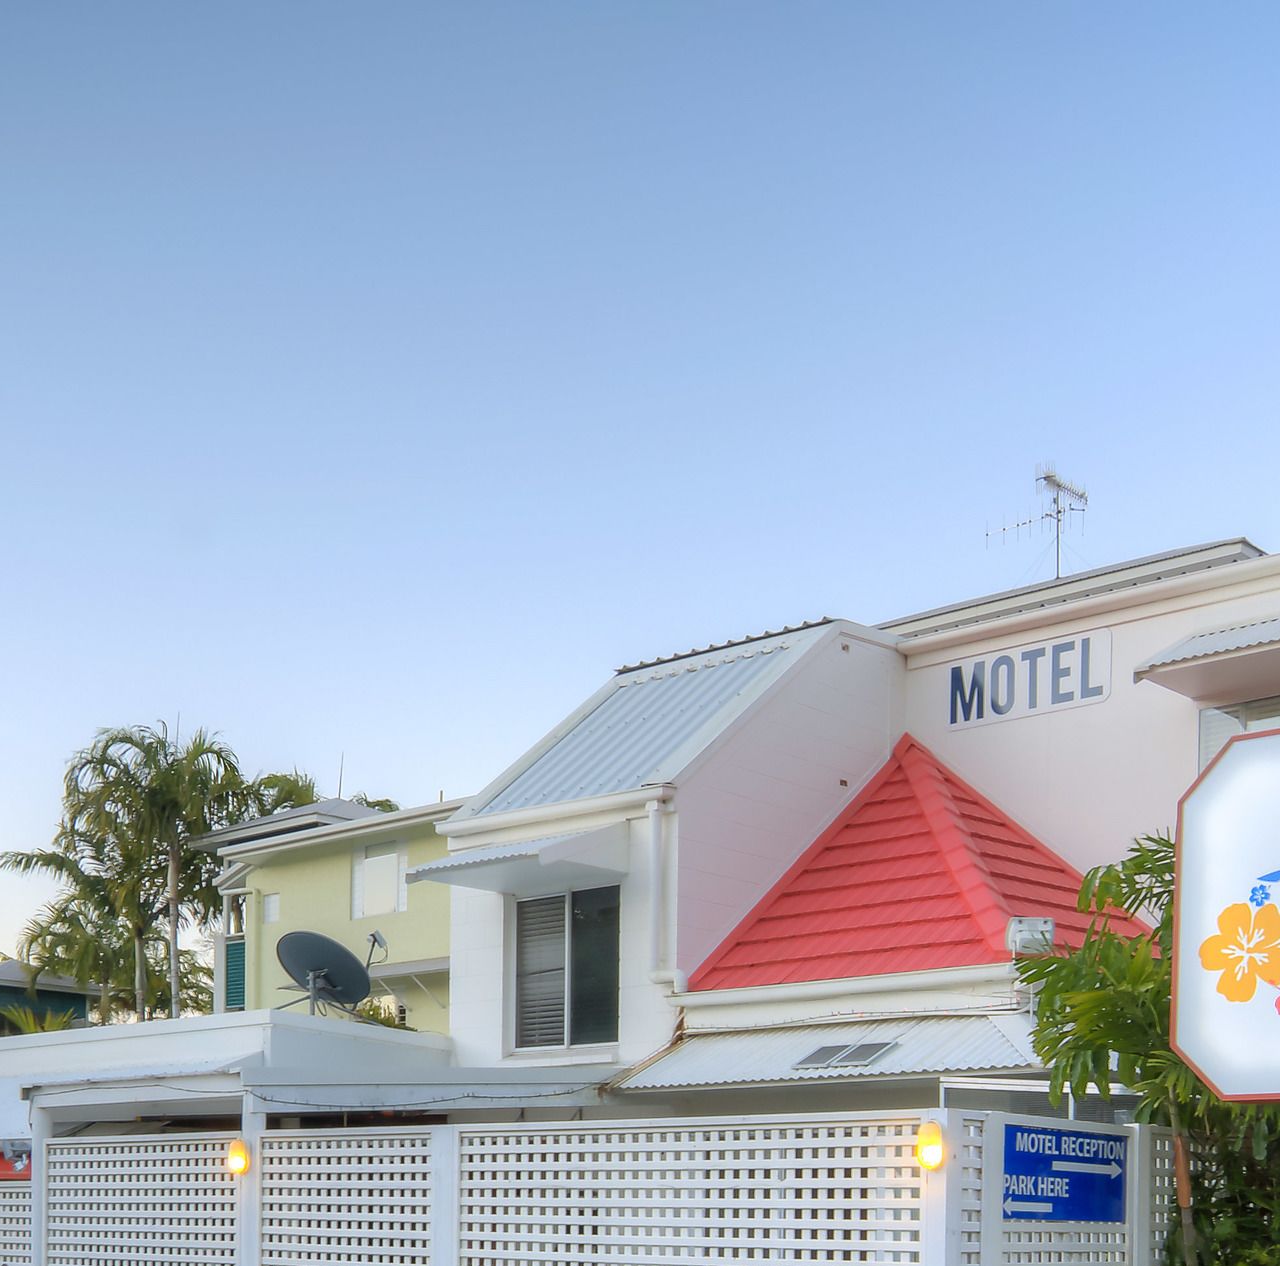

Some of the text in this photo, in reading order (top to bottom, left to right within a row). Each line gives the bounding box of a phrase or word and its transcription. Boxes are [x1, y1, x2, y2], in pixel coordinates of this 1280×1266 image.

[950, 637, 1103, 725] MOTEL
[1015, 1132, 1125, 1160] MOTEL RECEPTION
[1003, 1174, 1069, 1198] PARK HERE
